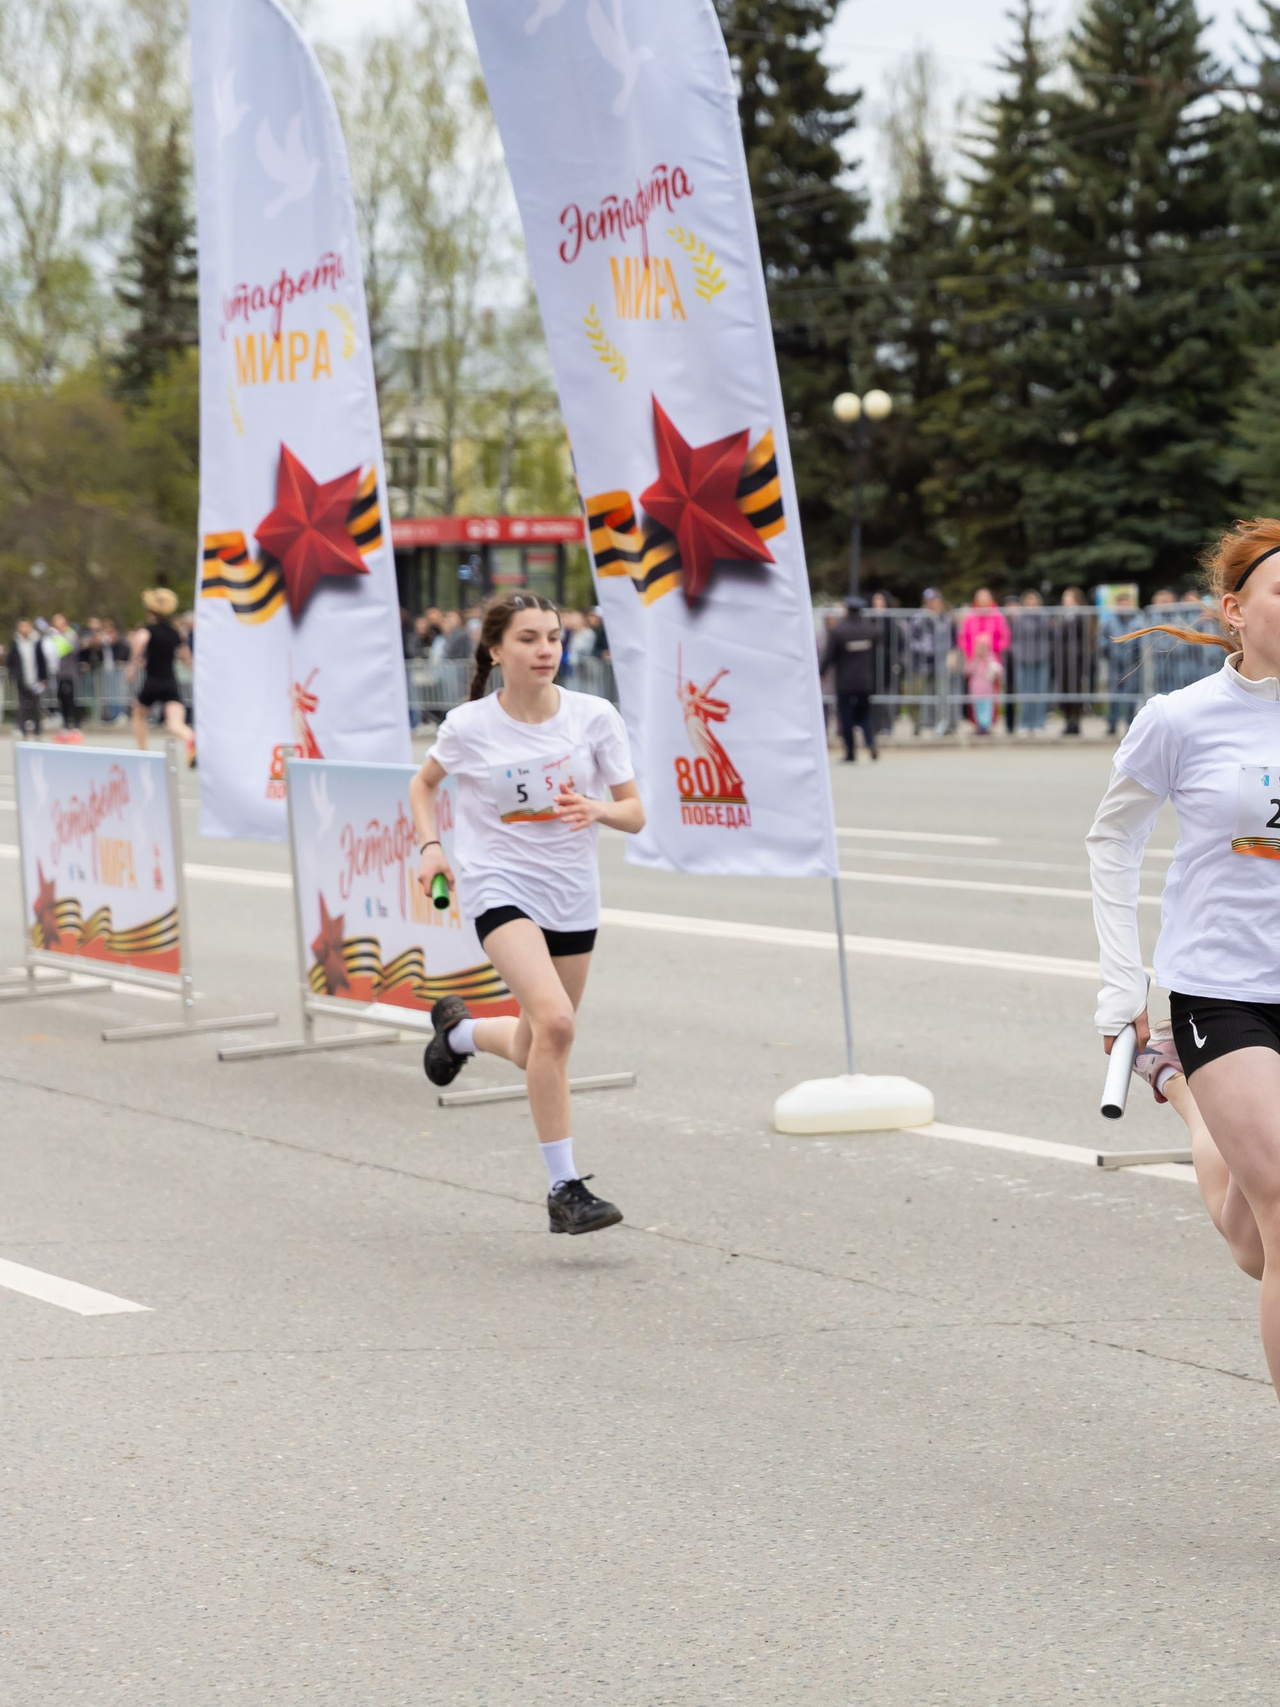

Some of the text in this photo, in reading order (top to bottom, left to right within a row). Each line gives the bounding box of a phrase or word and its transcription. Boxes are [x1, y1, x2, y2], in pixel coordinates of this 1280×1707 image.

[233, 328, 332, 387] МИРА
[516, 776, 554, 803] 5 5
[674, 756, 715, 797] 80
[681, 804, 752, 830] ПОБЕДА!
